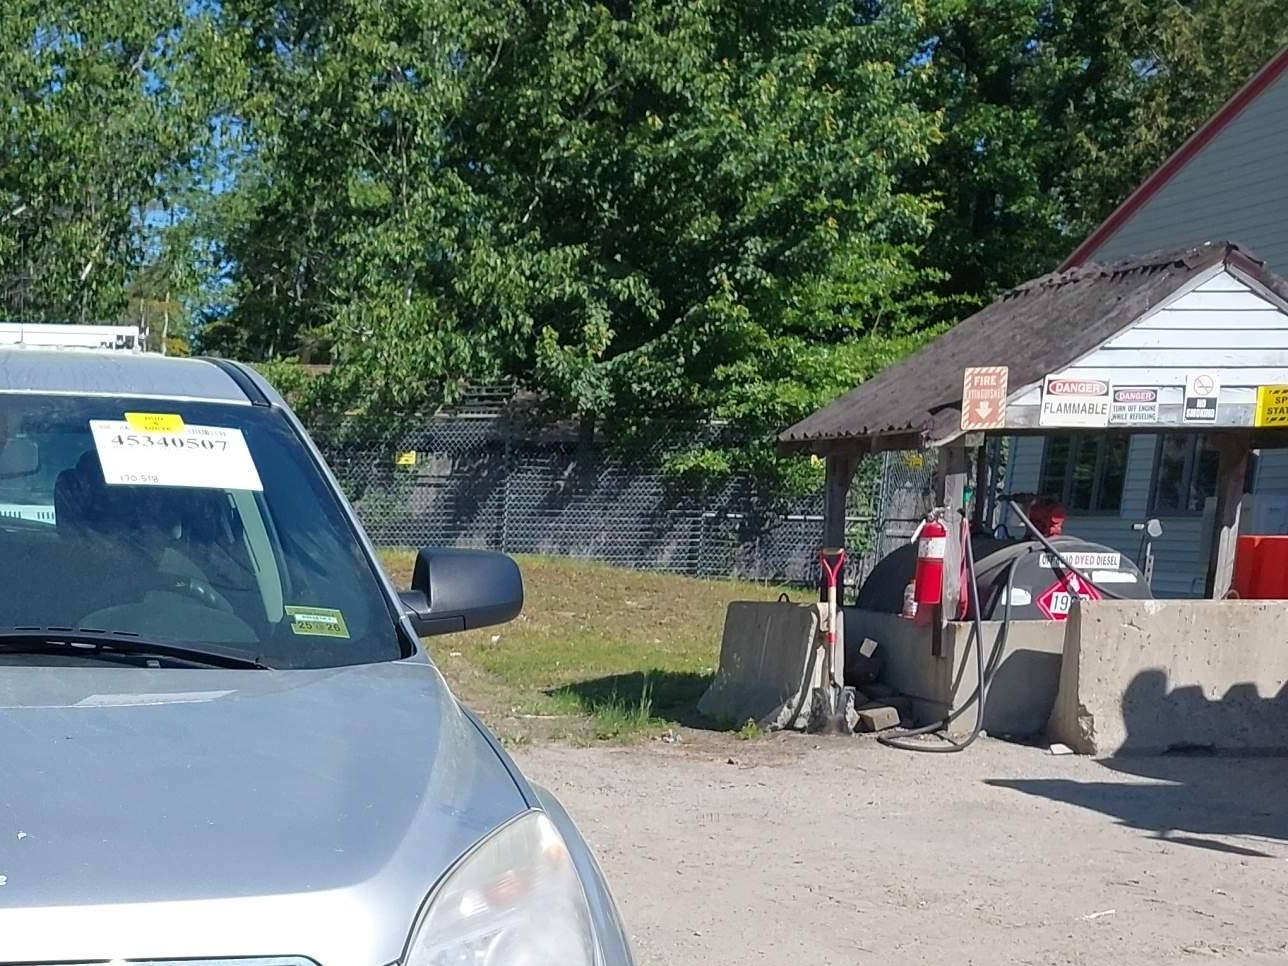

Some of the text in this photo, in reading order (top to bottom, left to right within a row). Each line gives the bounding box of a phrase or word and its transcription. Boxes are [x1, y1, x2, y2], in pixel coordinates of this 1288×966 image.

[973, 375, 997, 386] FIRE
[1055, 383, 1100, 394] DANGER
[1119, 391, 1151, 401] DANGER
[1043, 402, 1108, 415] FLAMMABLE
[1196, 398, 1207, 408] NO
[111, 434, 228, 451] 45340507
[1074, 554, 1095, 566] DYED
[1096, 554, 1118, 566] DIESEL
[298, 620, 341, 632] 25 26
